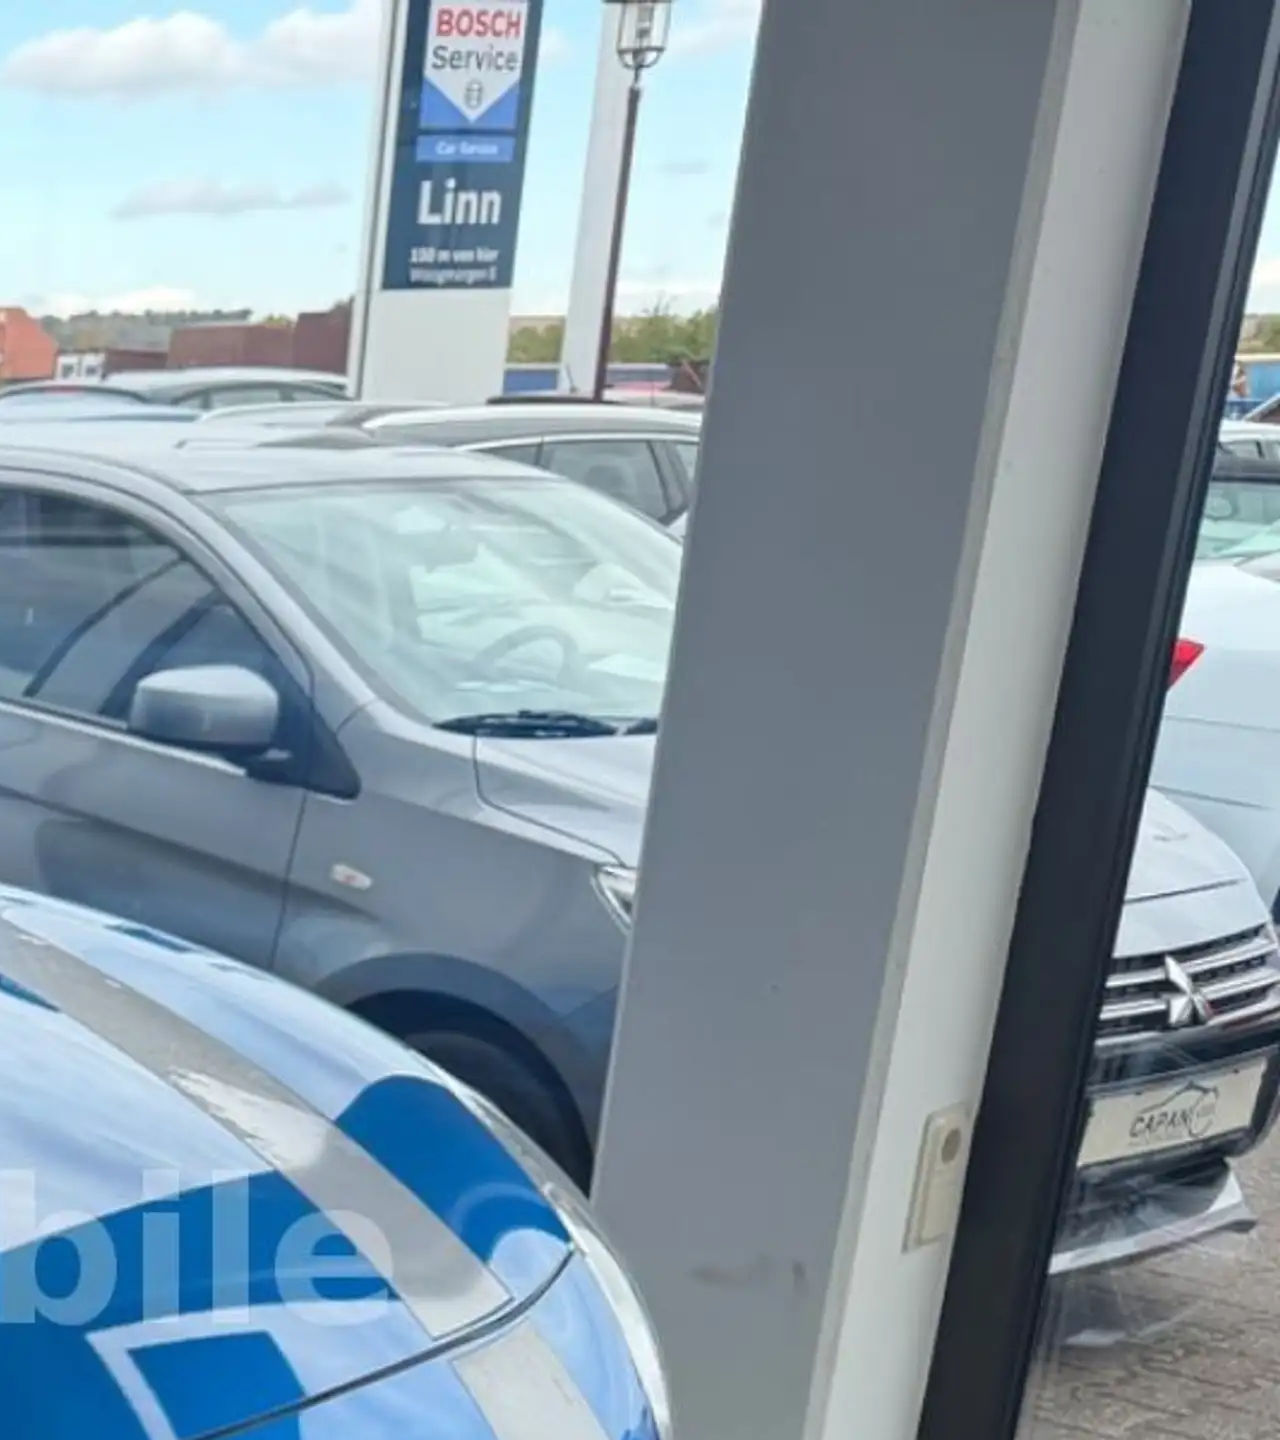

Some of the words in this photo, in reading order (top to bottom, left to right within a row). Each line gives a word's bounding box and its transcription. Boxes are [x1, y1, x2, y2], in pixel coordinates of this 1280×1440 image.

[435, 8, 522, 38] BOSCH
[430, 44, 519, 71] Service
[416, 177, 502, 225] Linn
